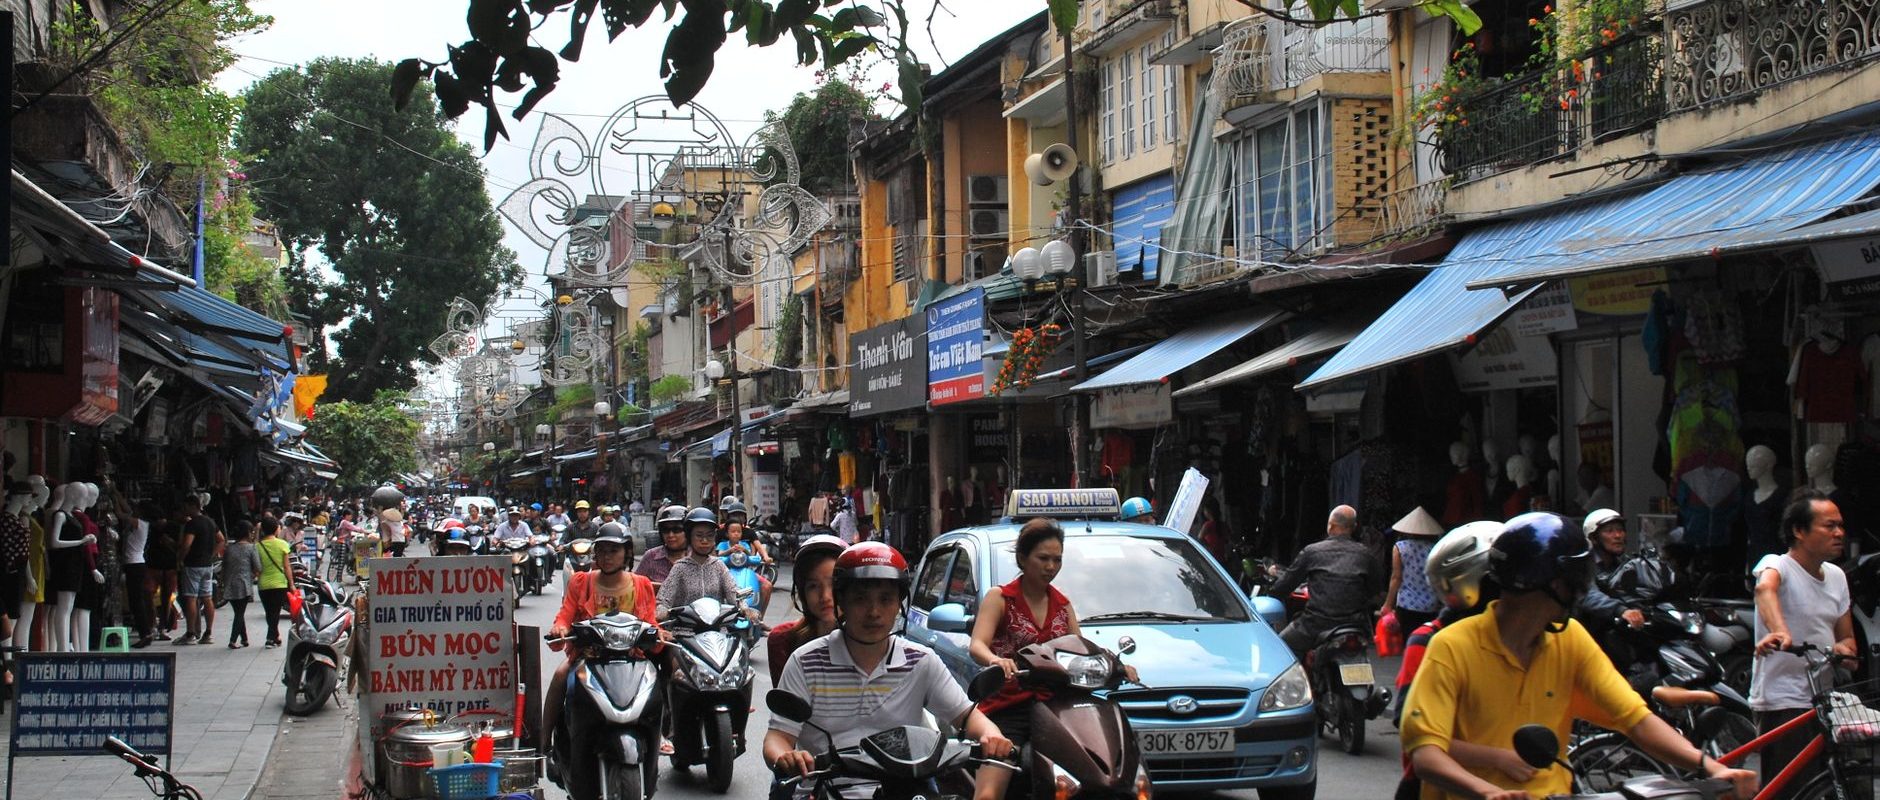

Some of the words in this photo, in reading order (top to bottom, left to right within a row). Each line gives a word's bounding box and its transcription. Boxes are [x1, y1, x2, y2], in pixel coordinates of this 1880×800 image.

[858, 337, 889, 370] Thanh
[892, 330, 913, 362] Vân
[1022, 492, 1048, 506] SAO
[376, 559, 435, 596] MIẾN
[441, 565, 505, 594] LƯƠN
[374, 606, 396, 623] GIA
[401, 600, 452, 622] TRUYỀN
[456, 599, 482, 622] PHỐ
[380, 629, 436, 658] BÚN
[444, 632, 500, 660] MỌC
[27, 659, 57, 680] TUYẾN
[60, 659, 79, 680] PHỐ
[82, 661, 102, 680] VĂN
[104, 664, 131, 680] MINH
[149, 664, 165, 683] THỊ
[371, 663, 424, 693] BÁNH
[430, 662, 457, 691] MỲ
[462, 660, 511, 690] PATÊ
[1143, 731, 1230, 752] 30K-8757
